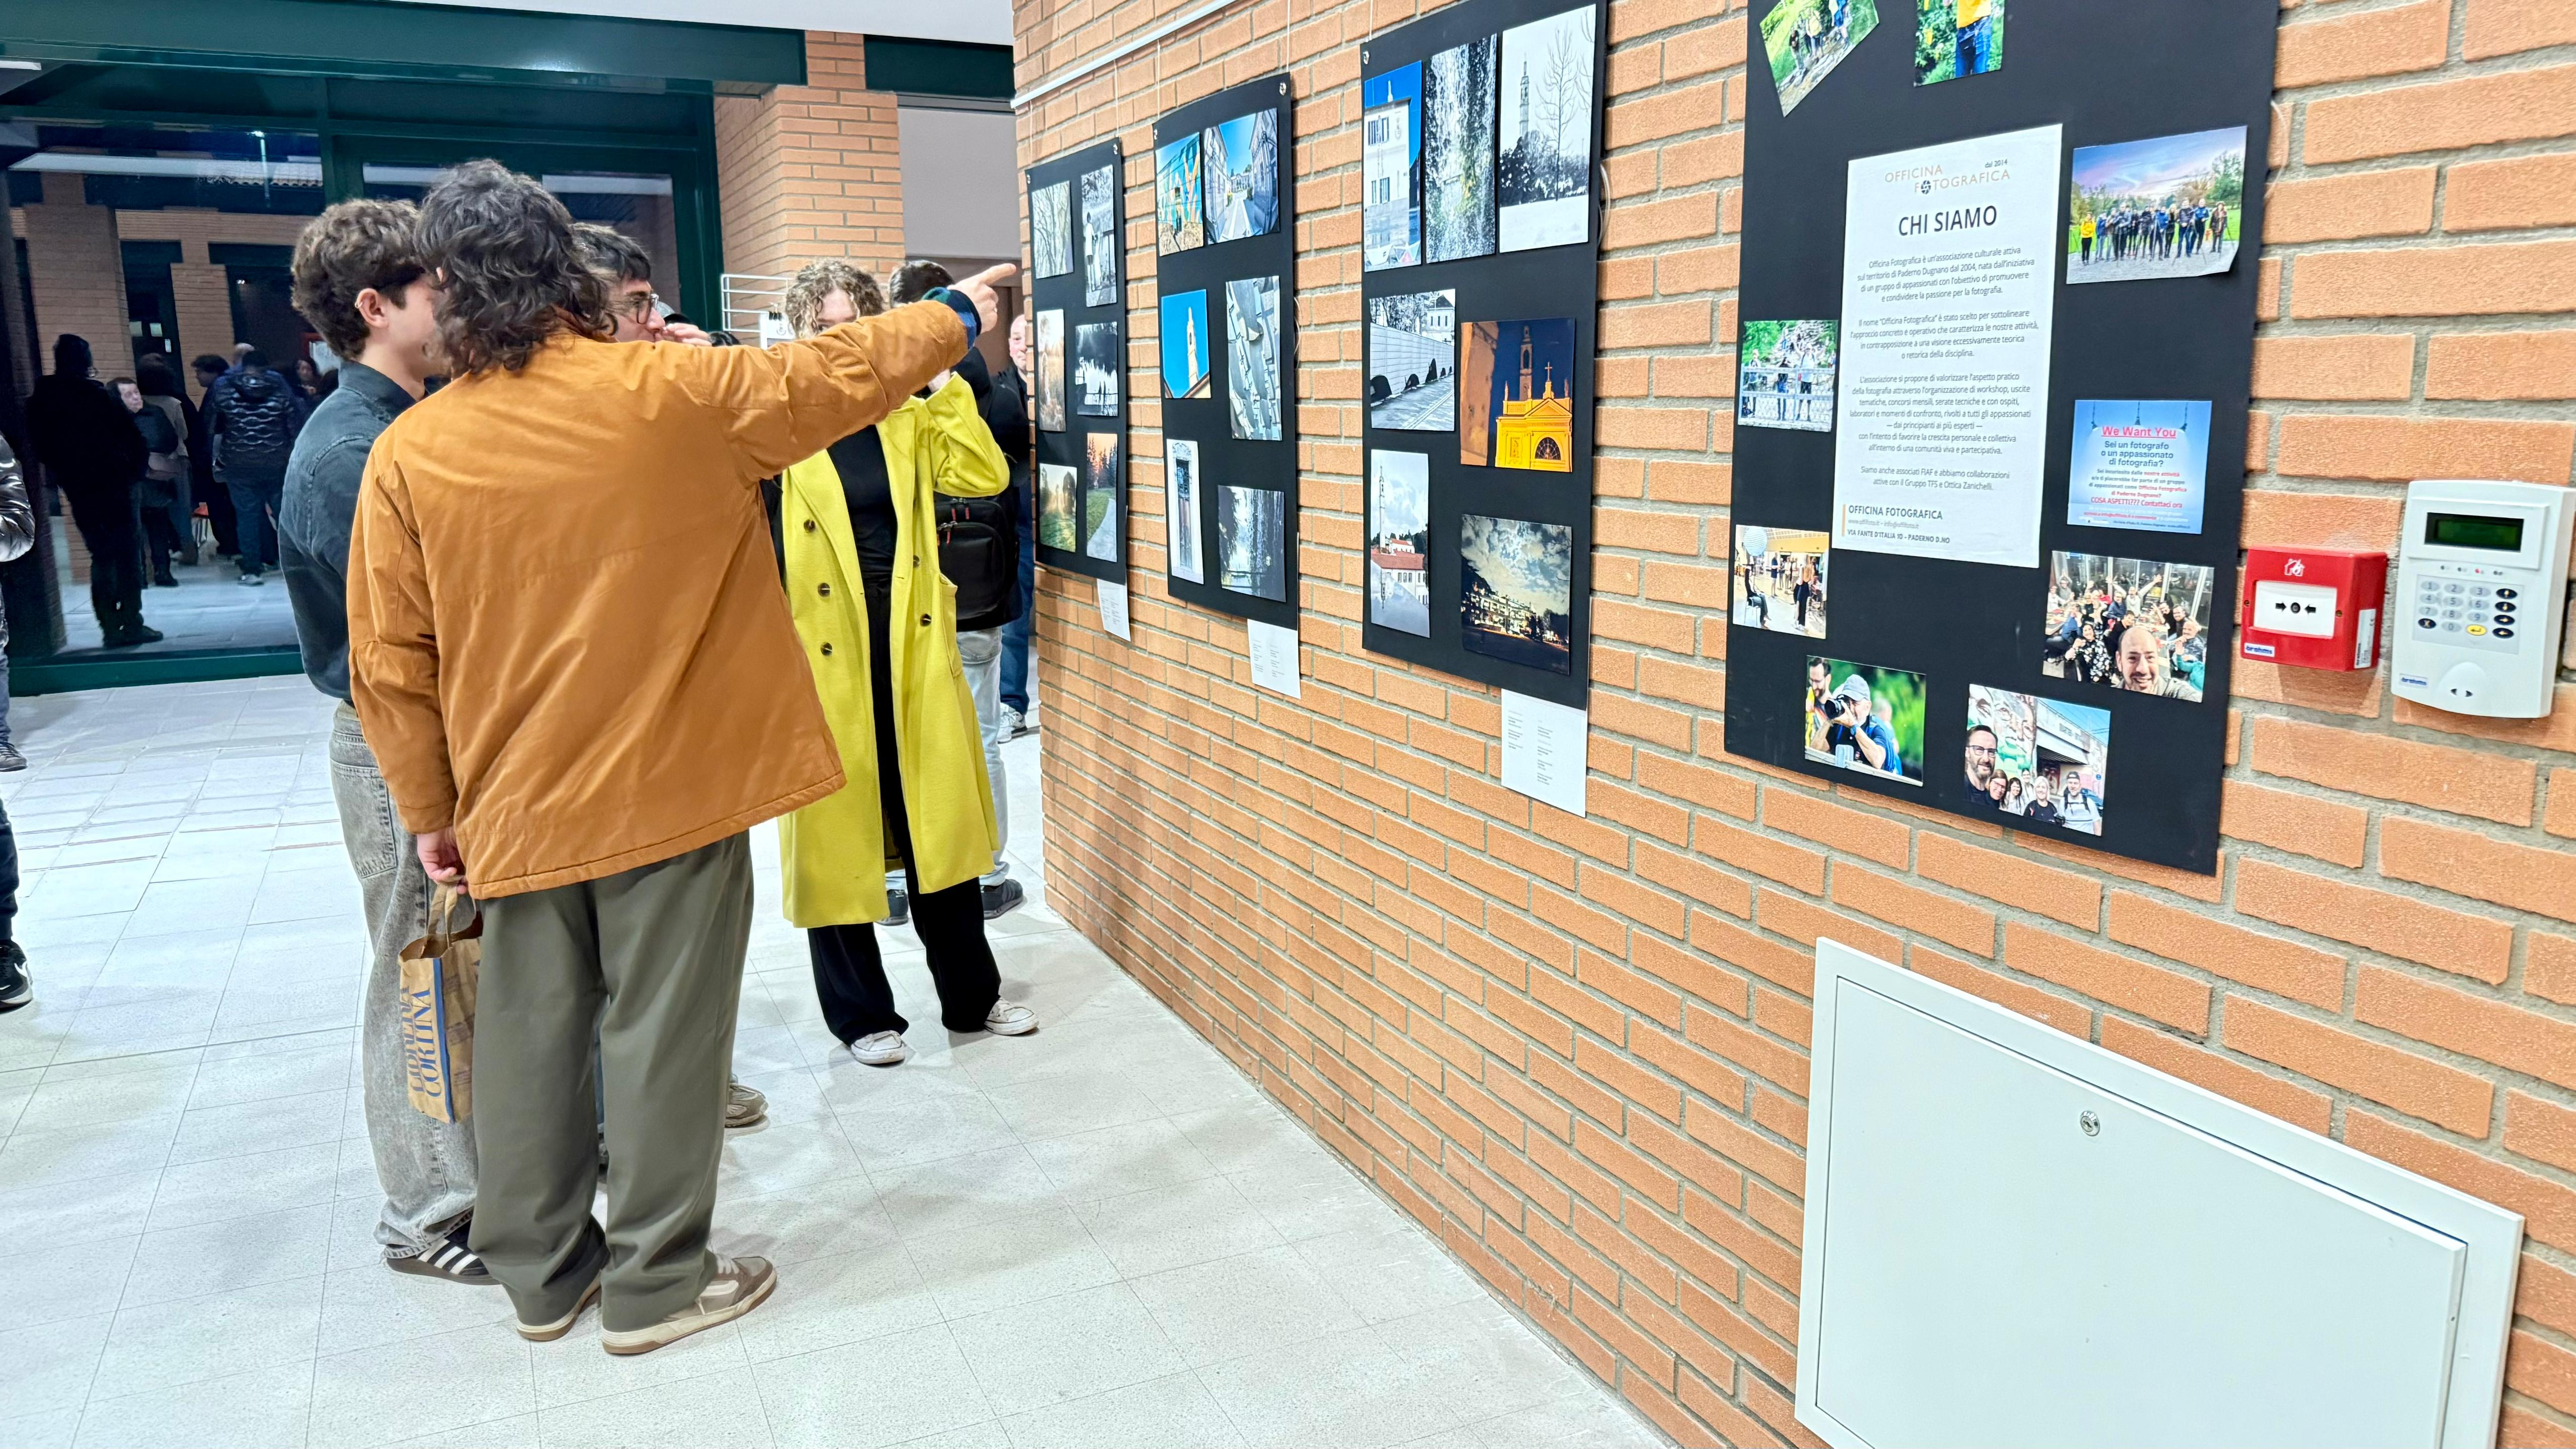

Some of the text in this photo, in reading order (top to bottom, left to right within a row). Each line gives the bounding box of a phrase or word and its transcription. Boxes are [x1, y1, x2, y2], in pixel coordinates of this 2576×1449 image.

[1885, 165, 1942, 182] OFFICINA
[1899, 205, 1996, 235] CHI SIAMO
[1869, 260, 1890, 268] Officina
[1890, 256, 1921, 266] Fotografica
[1974, 248, 2001, 258] culturale
[1857, 273, 1865, 281] sul
[1866, 272, 1890, 280] territorio
[1922, 267, 1949, 276] Dugnano
[1950, 264, 1959, 272] dal
[1875, 284, 1895, 292] gruppo
[1902, 279, 1938, 290] appassionati
[1989, 273, 2029, 283] promuovere
[1886, 293, 1918, 301] condividere
[1925, 291, 1951, 300] passione
[1960, 312, 1977, 320] scelto
[1978, 313, 1989, 321] per
[1990, 310, 2029, 318] sottolineare
[1909, 328, 1936, 337] operativo
[1949, 325, 1984, 333] caratterizza
[1866, 341, 1912, 349] contrapposizione
[1996, 372, 2020, 382] pratico
[1989, 410, 2031, 419] appassionati
[1903, 422, 1935, 431] principianti
[1942, 421, 1952, 431] più
[1953, 422, 1974, 431] esperti
[2102, 426, 2176, 437] We Want You
[1951, 434, 1981, 443] personale
[2130, 441, 2169, 451] fotografo
[2118, 458, 2163, 467] fotografia?
[1939, 469, 1965, 477] abbiamo
[1966, 470, 2009, 478] collaborazioni
[1904, 479, 1926, 488] Gruppo
[1944, 480, 1961, 489] Ottica
[1848, 505, 1943, 519] OFFICINA FOTOGRAFICA
[1908, 534, 1934, 542] PADERNO
